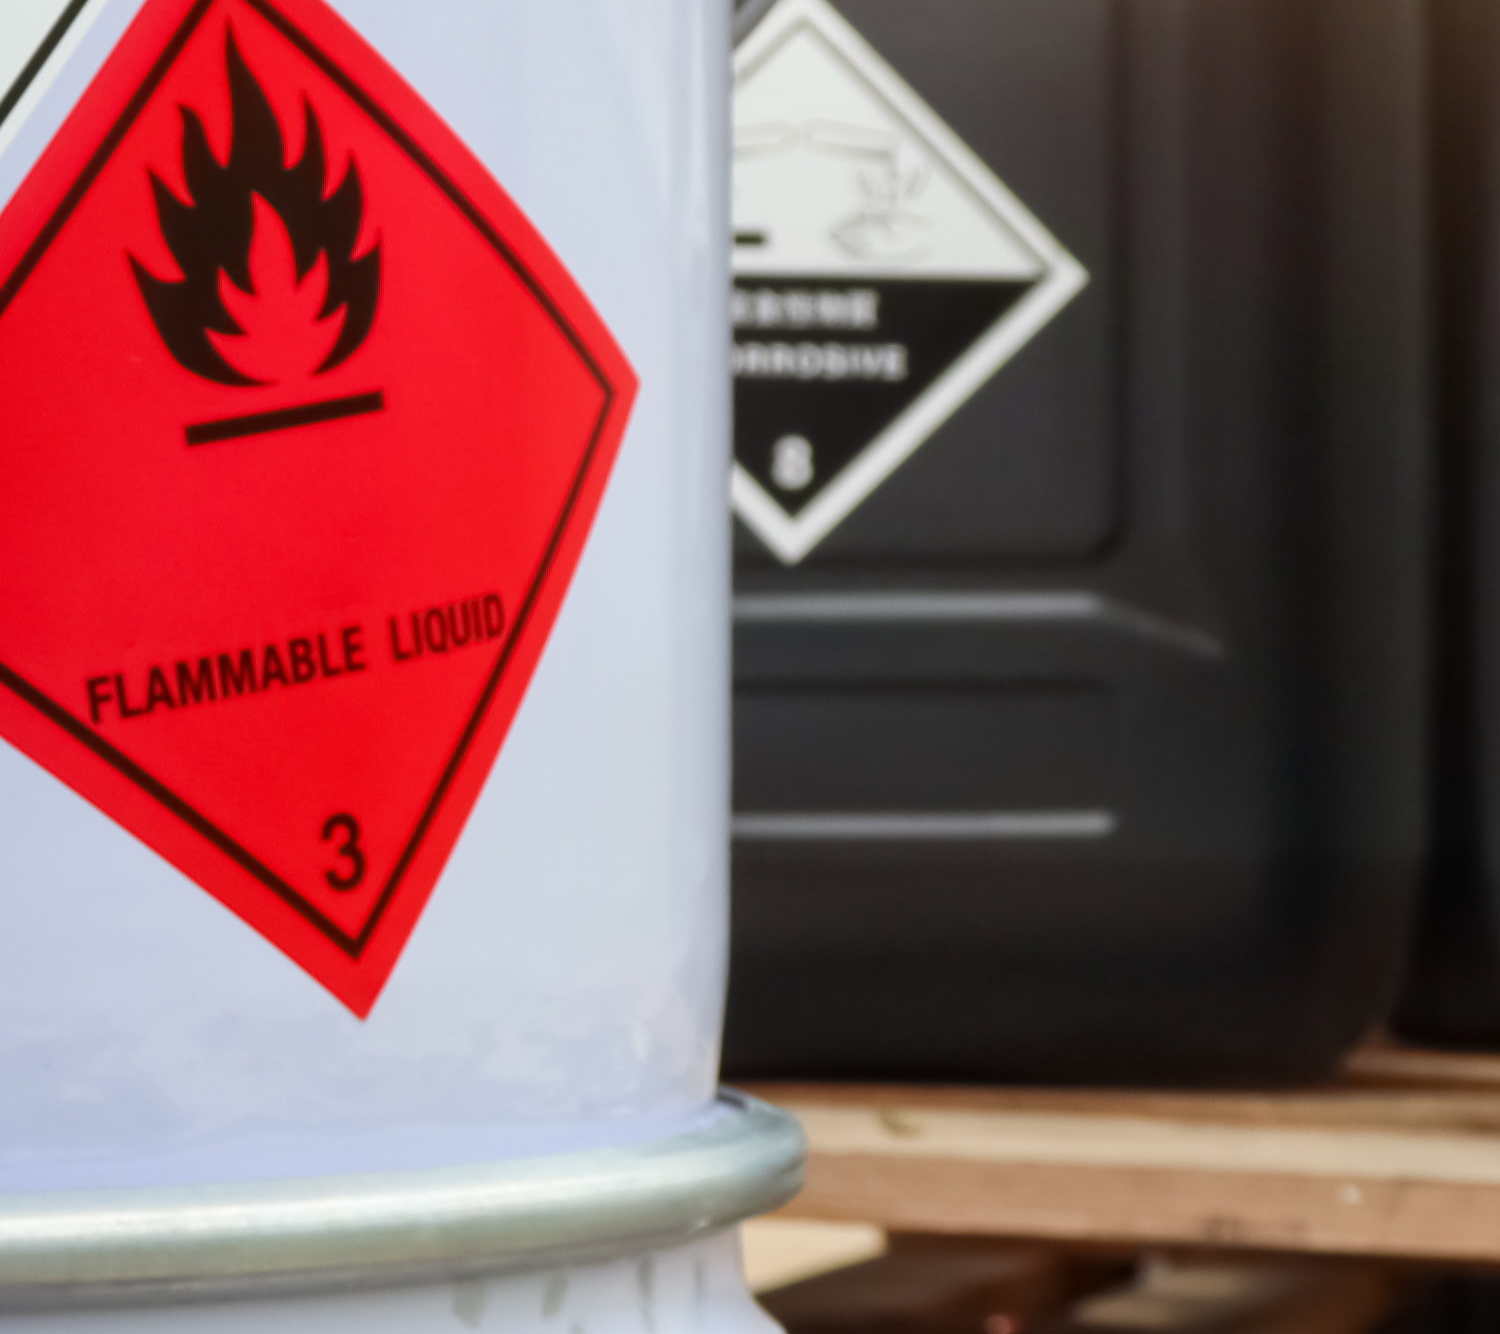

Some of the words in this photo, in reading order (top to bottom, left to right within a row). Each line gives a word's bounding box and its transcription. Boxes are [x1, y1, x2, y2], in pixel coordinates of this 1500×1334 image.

[771, 434, 813, 491] 8
[86, 625, 367, 724] FLAMMABLE
[388, 592, 507, 662] LIQUID
[321, 812, 366, 892] 3
